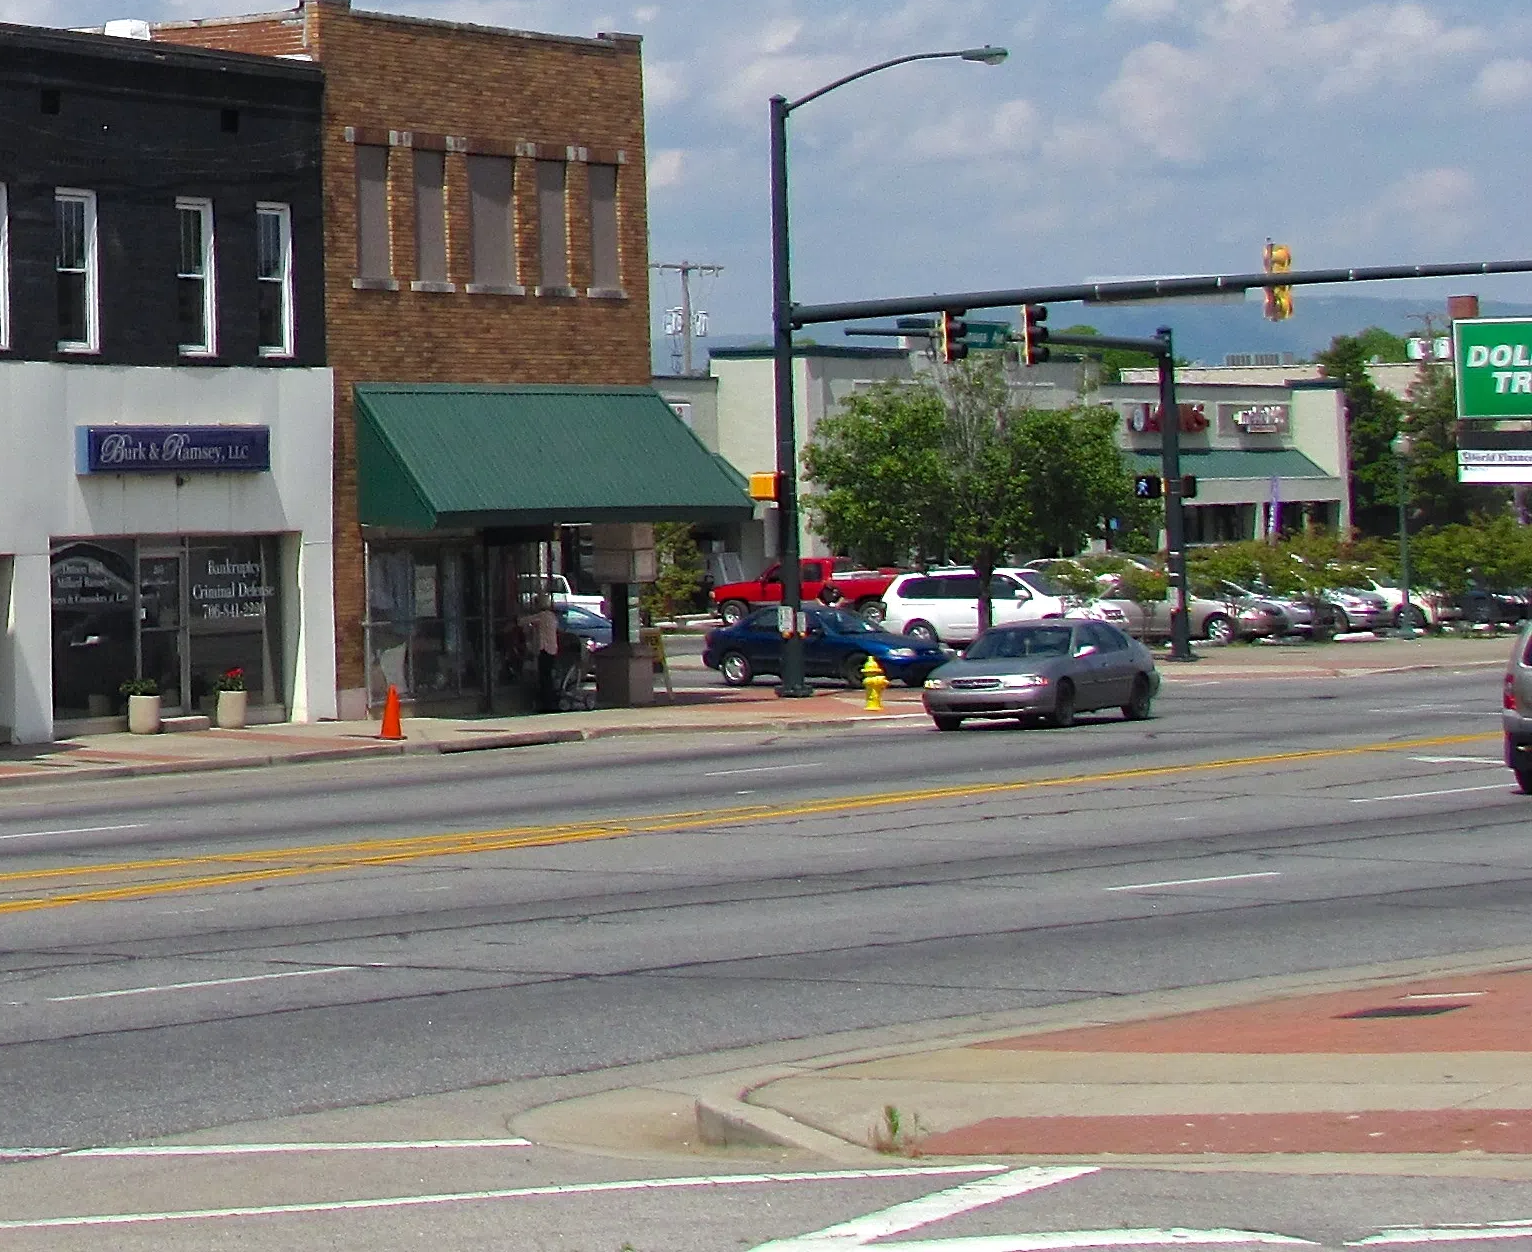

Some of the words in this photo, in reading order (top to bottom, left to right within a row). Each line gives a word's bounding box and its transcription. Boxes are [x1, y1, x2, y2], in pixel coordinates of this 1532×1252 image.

[1466, 344, 1532, 368] DOL
[100, 433, 147, 463] Burk
[148, 443, 160, 461] &
[162, 433, 226, 463] Ramsey,
[228, 445, 249, 460] LLC
[208, 558, 260, 578] Bankruptcy
[192, 581, 236, 599] Criminal
[238, 580, 275, 598] Defense
